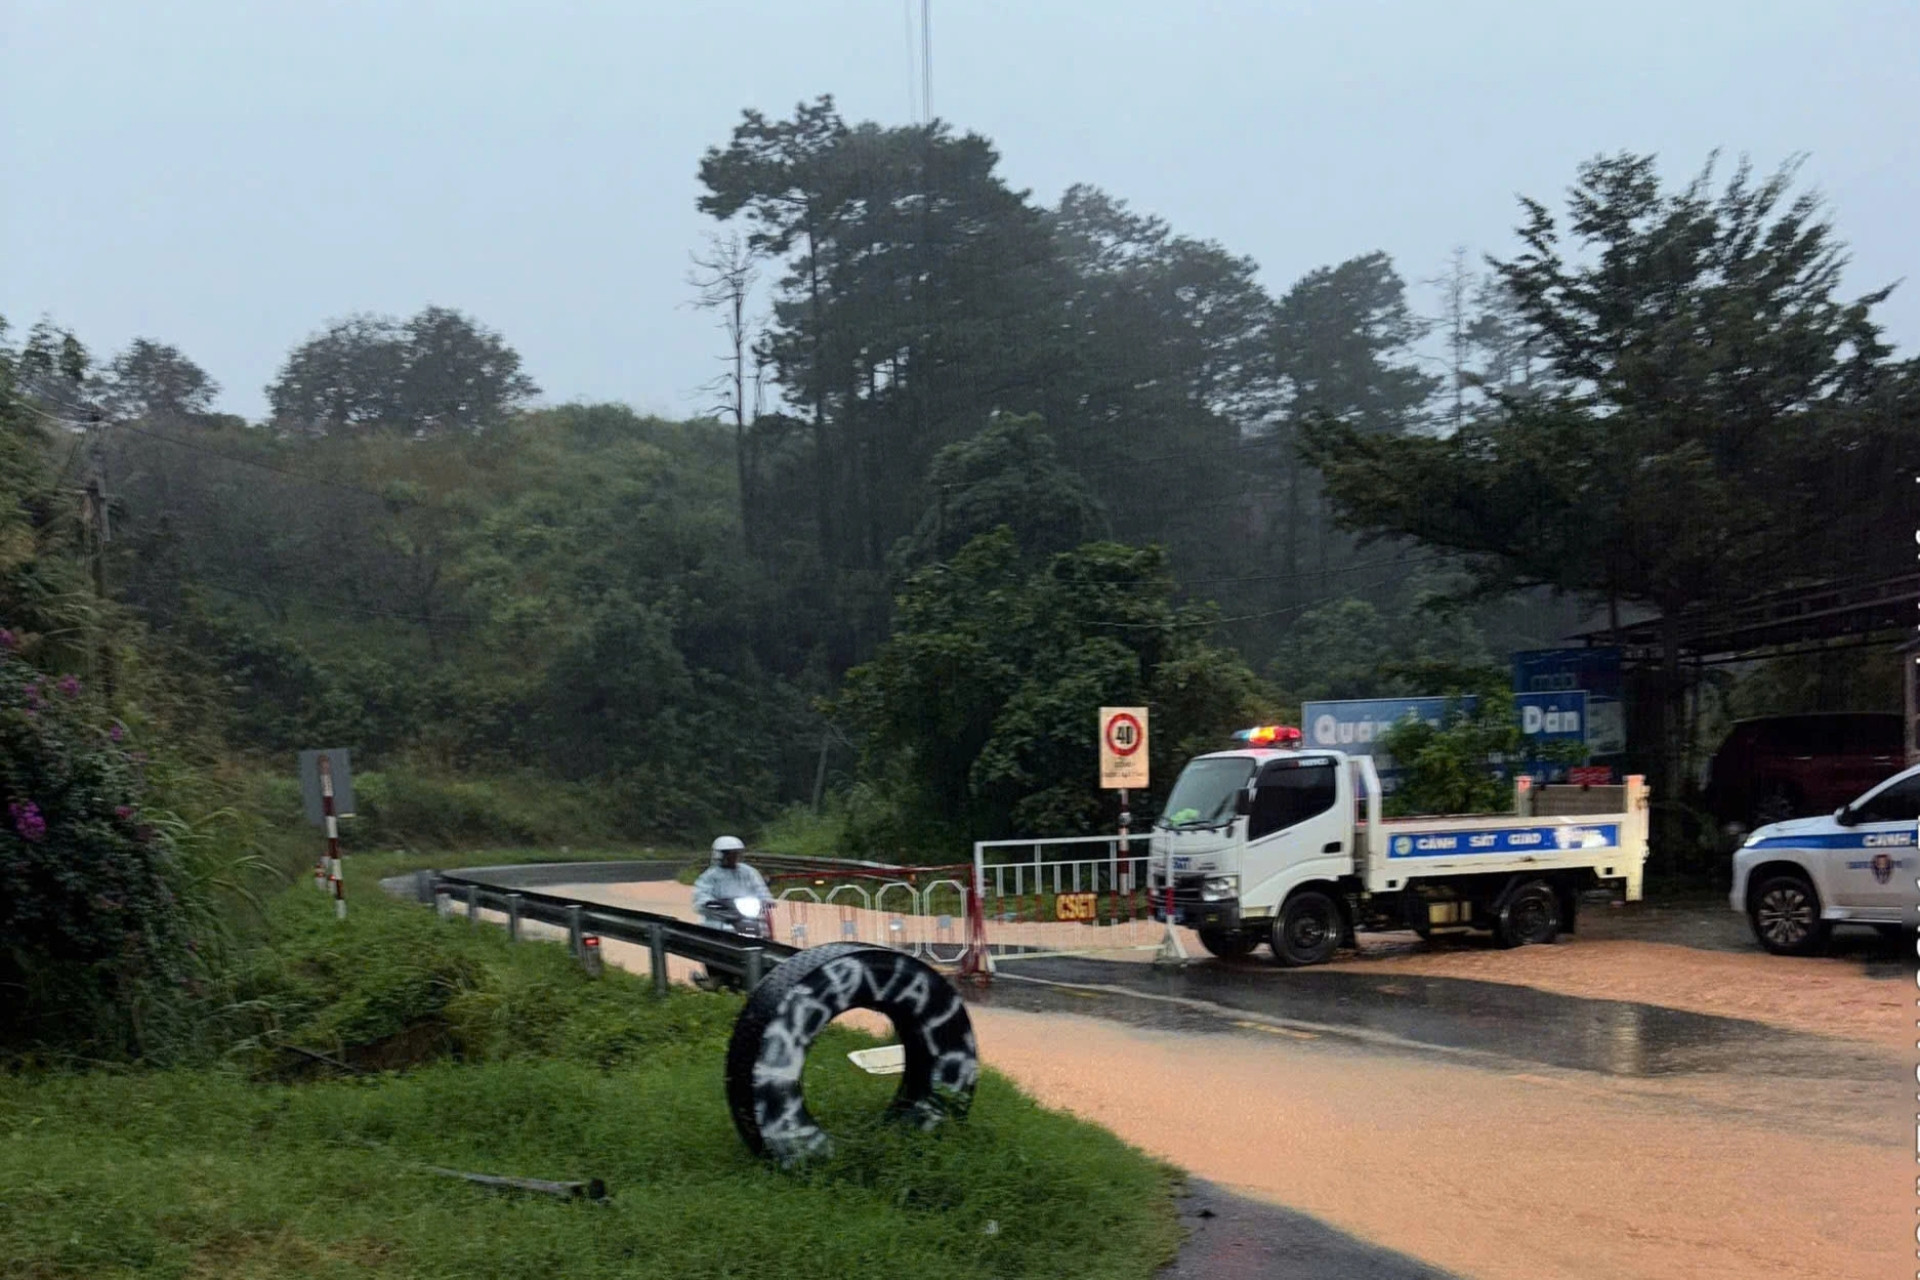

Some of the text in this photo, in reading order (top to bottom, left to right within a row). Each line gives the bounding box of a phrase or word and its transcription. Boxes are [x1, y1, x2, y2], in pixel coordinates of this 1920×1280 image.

[1522, 704, 1580, 734] Dân
[1115, 725, 1133, 745] 40
[1056, 893, 1097, 920] CSGT
